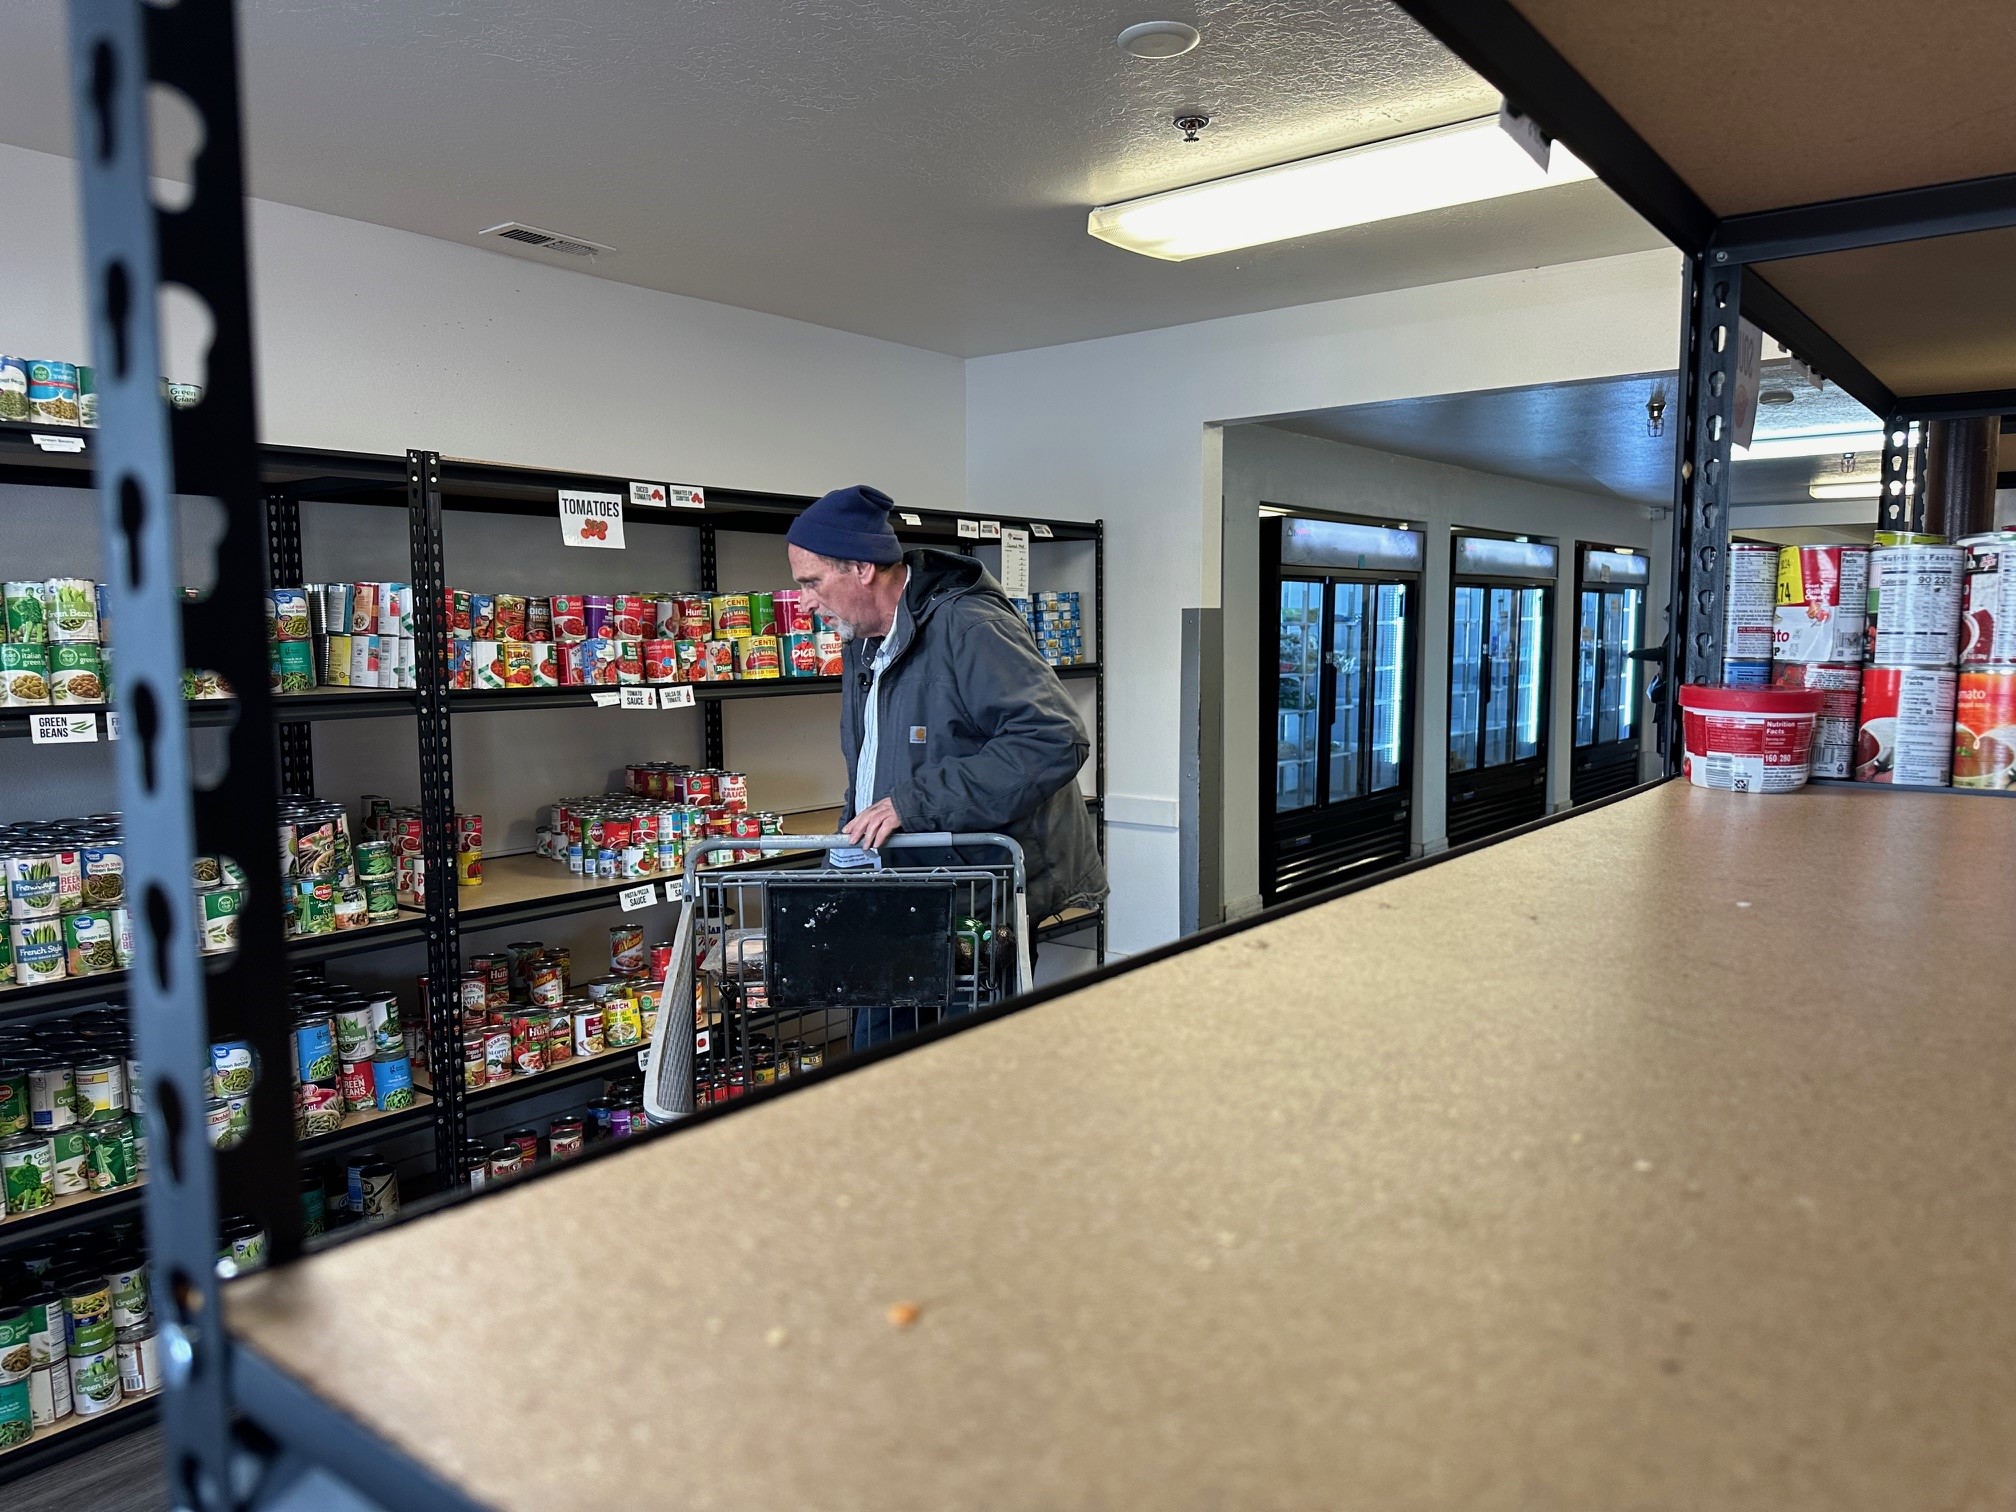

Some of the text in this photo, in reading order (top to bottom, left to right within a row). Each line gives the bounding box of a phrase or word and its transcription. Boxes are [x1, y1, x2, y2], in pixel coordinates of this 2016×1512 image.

[170, 388, 196, 397] Green
[174, 395, 197, 403] Giant
[634, 492, 652, 501] TOMATO
[561, 498, 620, 517] TOMATOES
[1882, 554, 1926, 562] Nutrition
[1918, 576, 1931, 584] 90
[1934, 576, 1952, 584] 230
[69, 608, 94, 618] Beans
[1772, 631, 1790, 643] ato
[791, 648, 816, 658] DICED
[1958, 689, 1987, 699] mato
[626, 697, 644, 706] SAUCE
[38, 717, 68, 728] GREEN
[40, 727, 69, 738] BEANS
[1764, 754, 1792, 763] 160 280
[721, 791, 746, 799] SAUCE
[61, 876, 81, 885] REEN
[61, 883, 81, 894] EANS
[629, 896, 647, 907] SAUCE
[19, 944, 62, 956] French Style
[607, 1002, 629, 1011] HATCH
[345, 1034, 367, 1042] Beans
[487, 1037, 501, 1049] STAR
[303, 1103, 318, 1112] Cut
[115, 1297, 138, 1307] Green
[94, 1372, 109, 1382] CUT
[77, 1382, 102, 1393] Green
